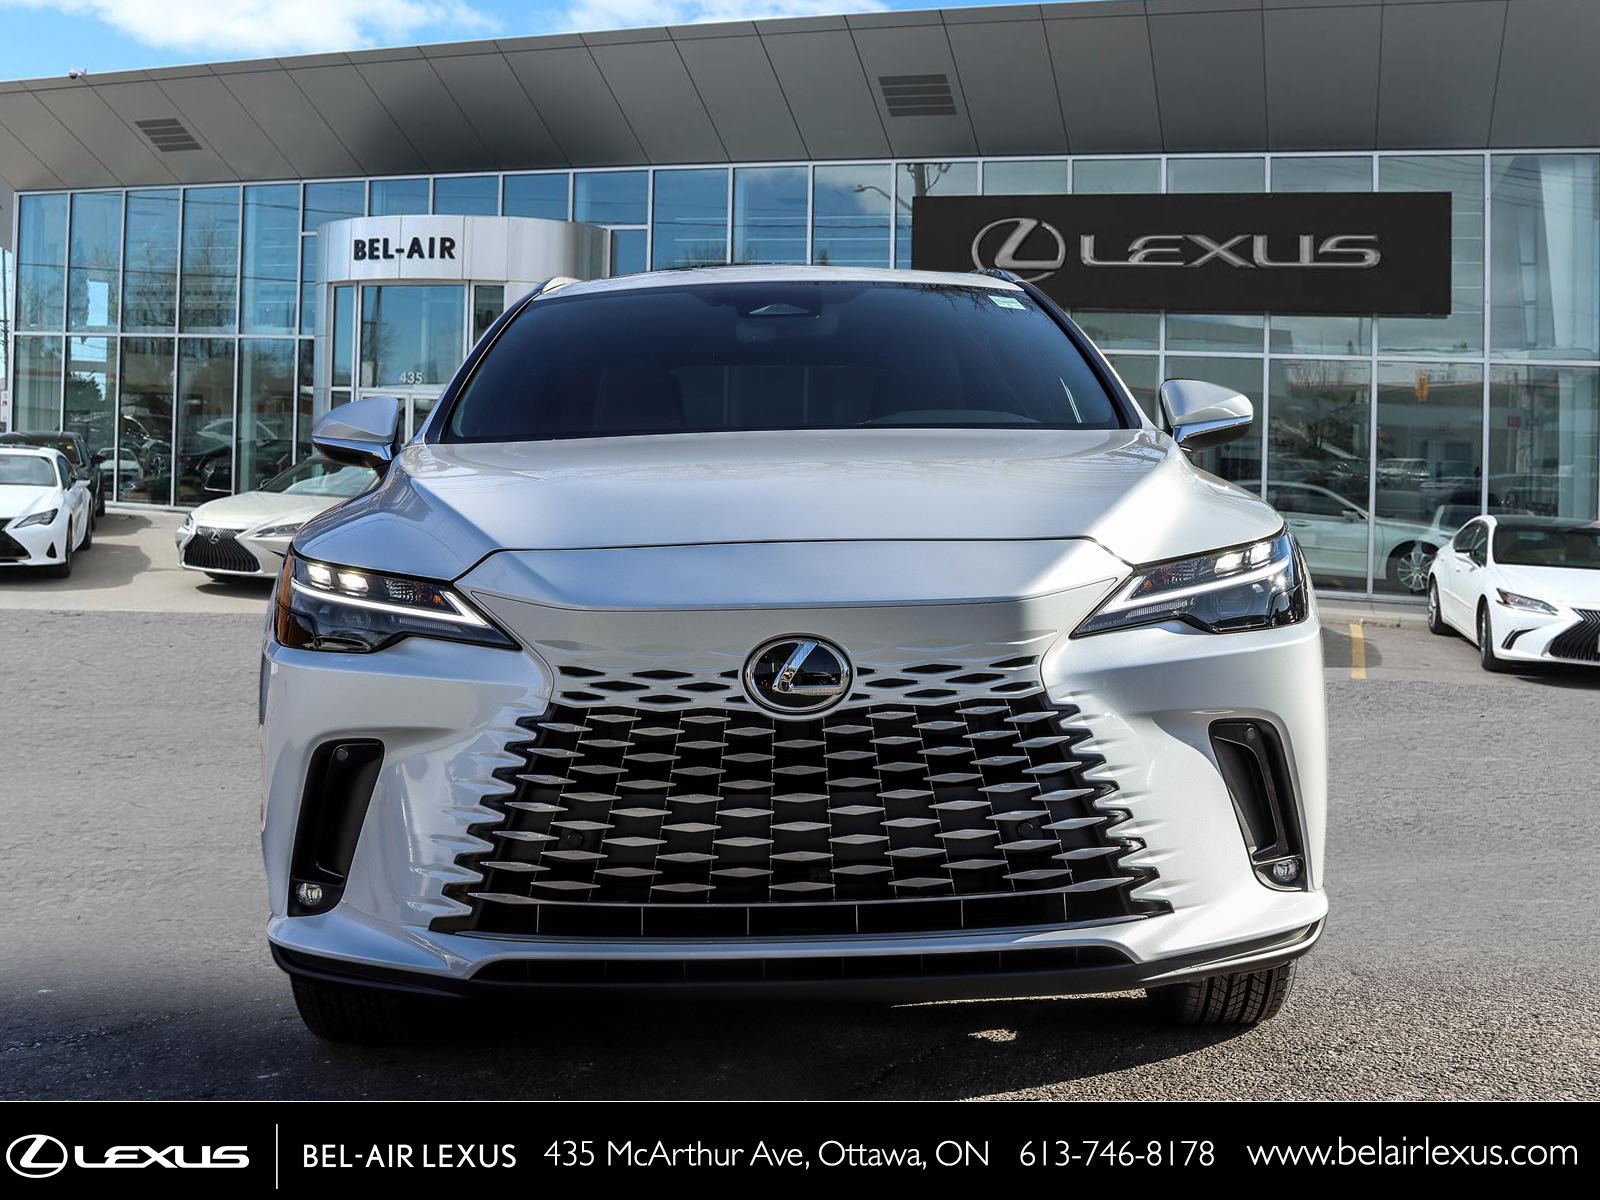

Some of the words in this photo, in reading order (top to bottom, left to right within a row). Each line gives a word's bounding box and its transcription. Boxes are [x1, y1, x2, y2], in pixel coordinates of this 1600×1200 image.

[353, 236, 456, 261] BEL-AIR
[1080, 234, 1381, 268] LEXUS
[400, 371, 423, 384] 435
